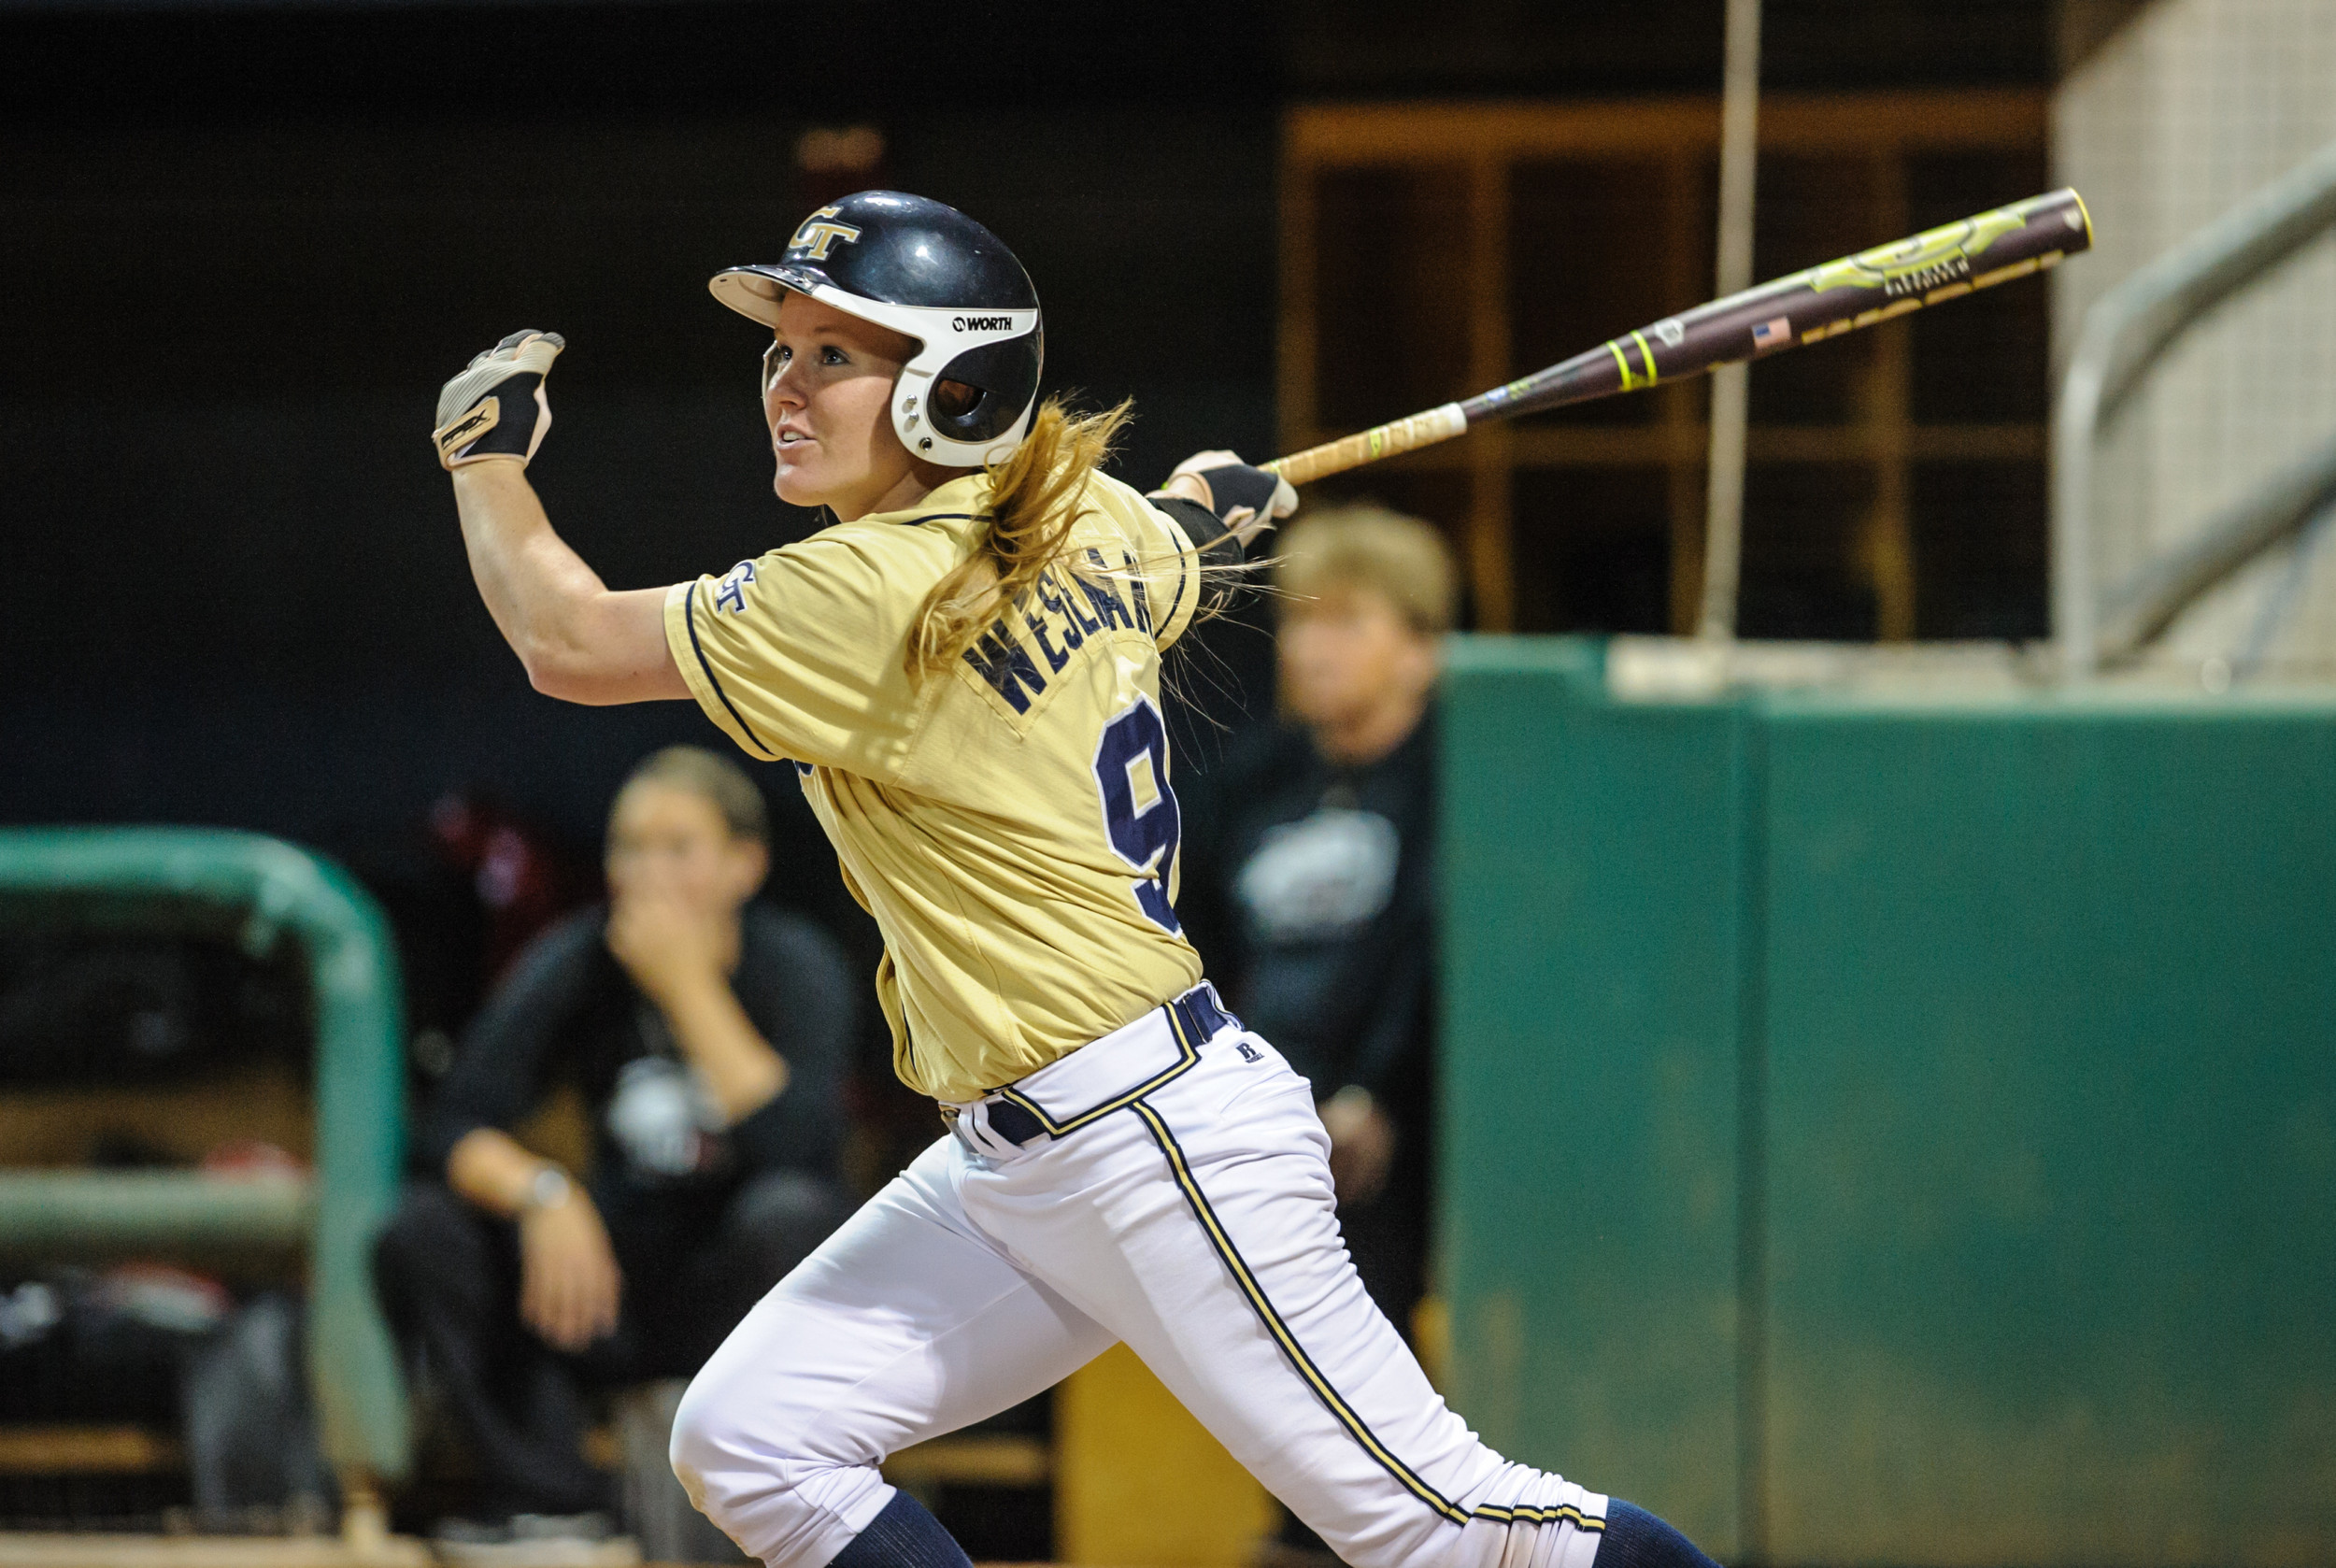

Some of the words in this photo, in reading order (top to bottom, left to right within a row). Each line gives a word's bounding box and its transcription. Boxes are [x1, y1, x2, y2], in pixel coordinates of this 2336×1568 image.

[788, 206, 861, 261] GT
[966, 317, 1012, 331] WORTH
[716, 559, 755, 612] GT
[1090, 691, 1184, 940] 9
